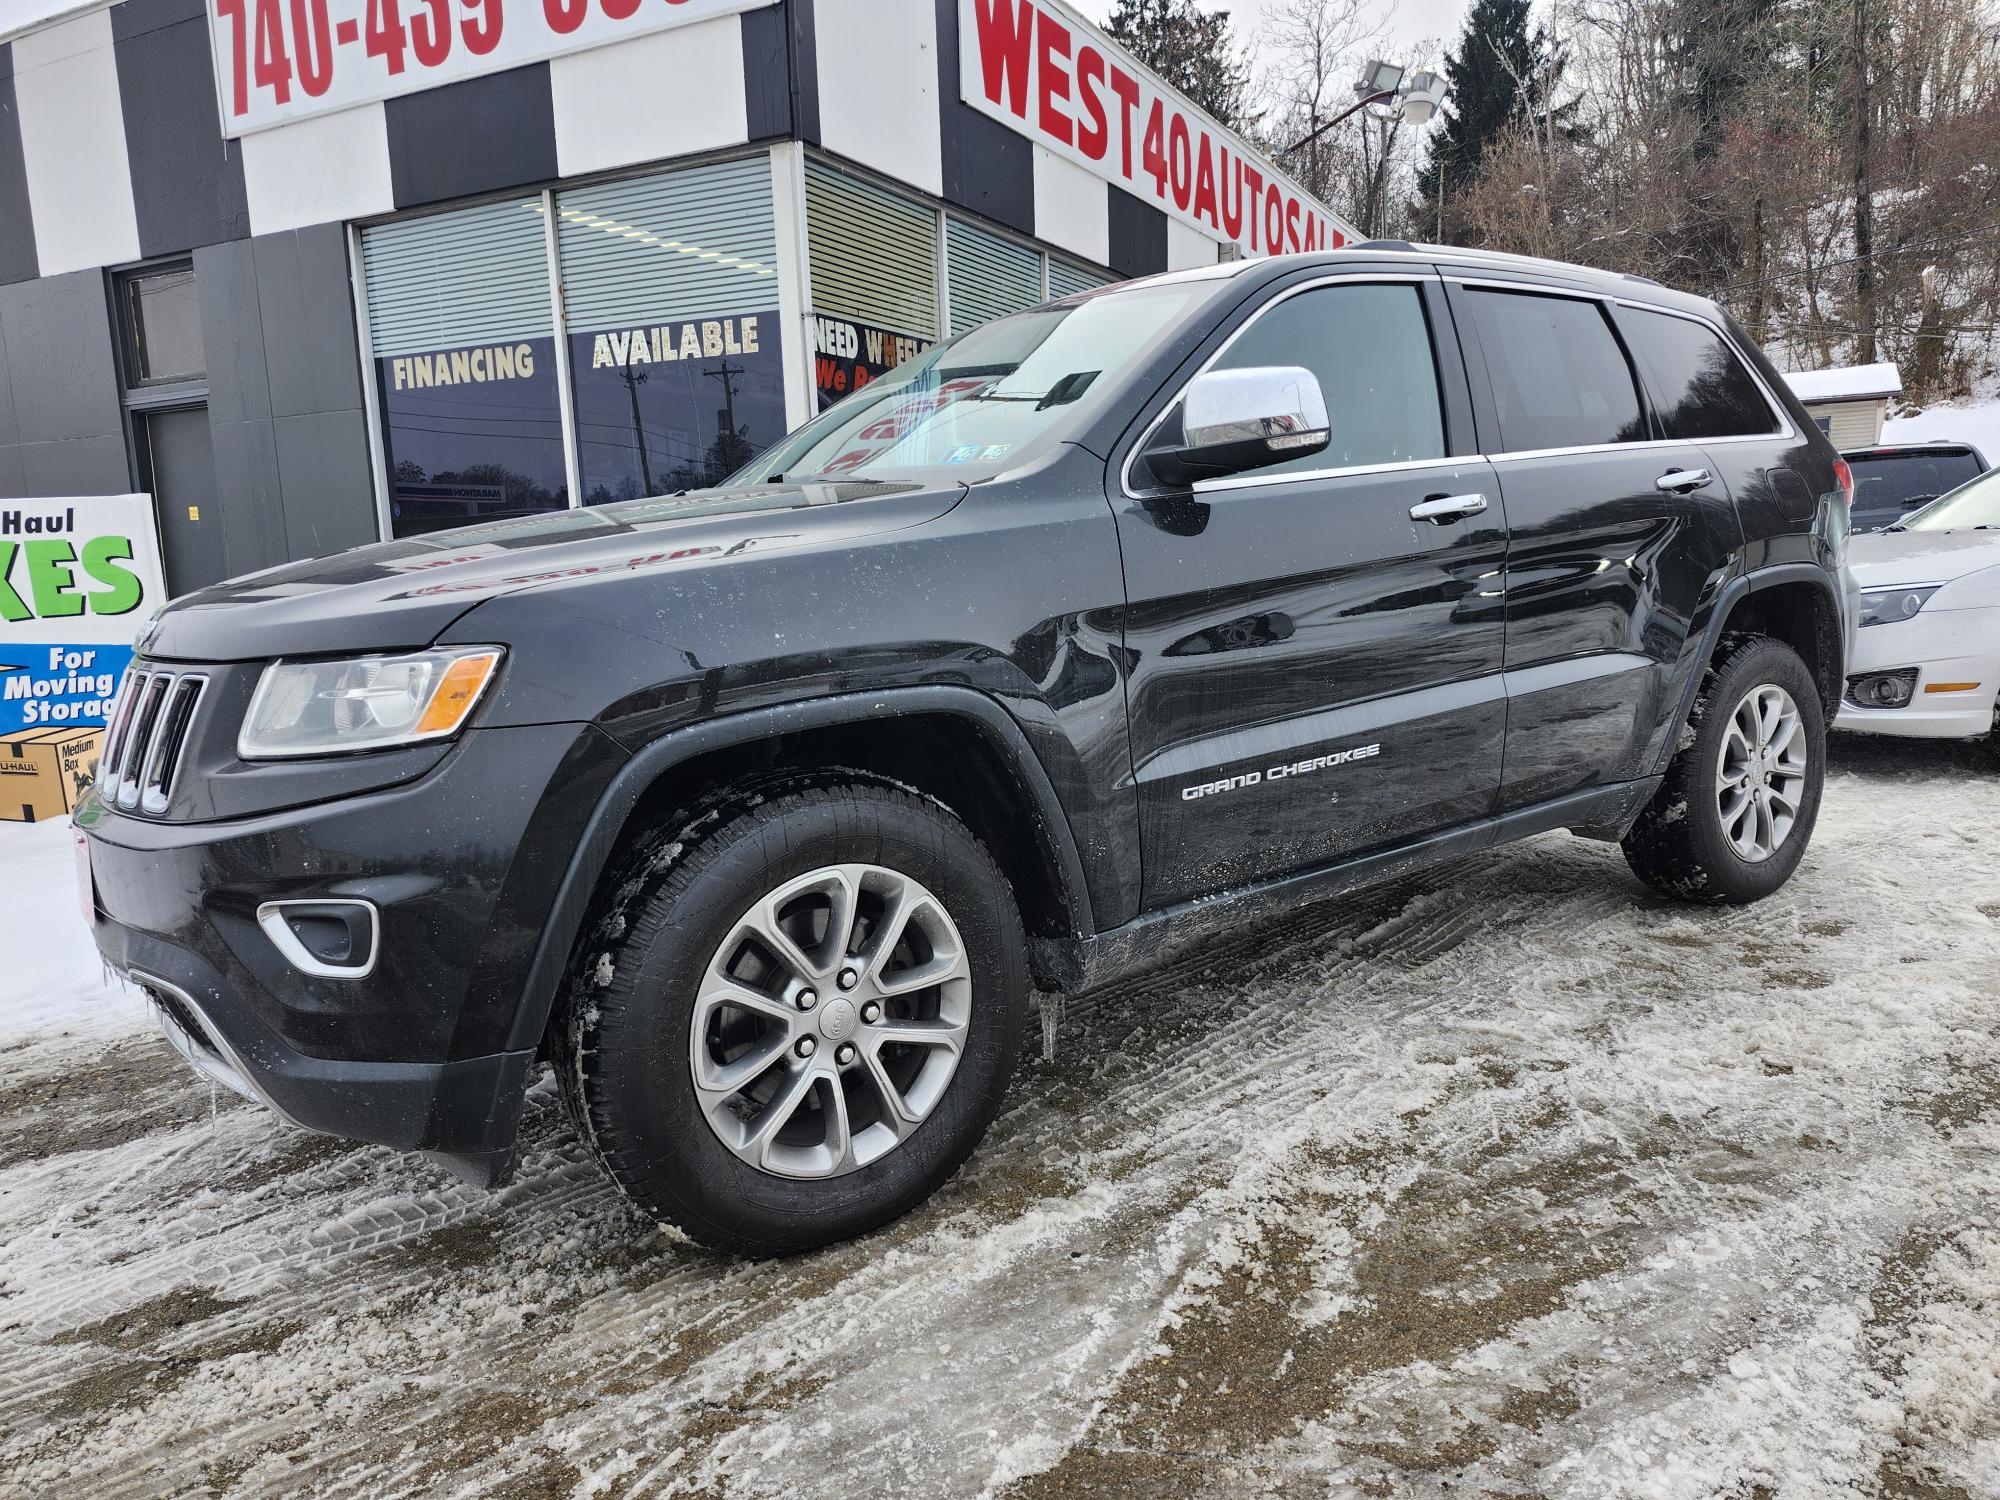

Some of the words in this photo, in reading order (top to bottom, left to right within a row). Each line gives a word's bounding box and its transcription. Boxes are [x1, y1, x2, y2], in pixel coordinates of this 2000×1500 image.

[974, 0, 1353, 257] WEST40AUTOSA
[392, 343, 535, 391] FINANCING
[592, 316, 760, 369] AVAILABLE
[813, 317, 859, 359] NEED
[864, 328, 937, 369] WHEE
[816, 358, 847, 392] We
[49, 647, 97, 672] For
[3, 670, 114, 700] Moving
[23, 699, 115, 724] Storag
[62, 739, 94, 759] Medium
[64, 758, 79, 773] Box
[1181, 771, 1262, 801] GRAND
[1266, 743, 1381, 781] CHEROKEE
